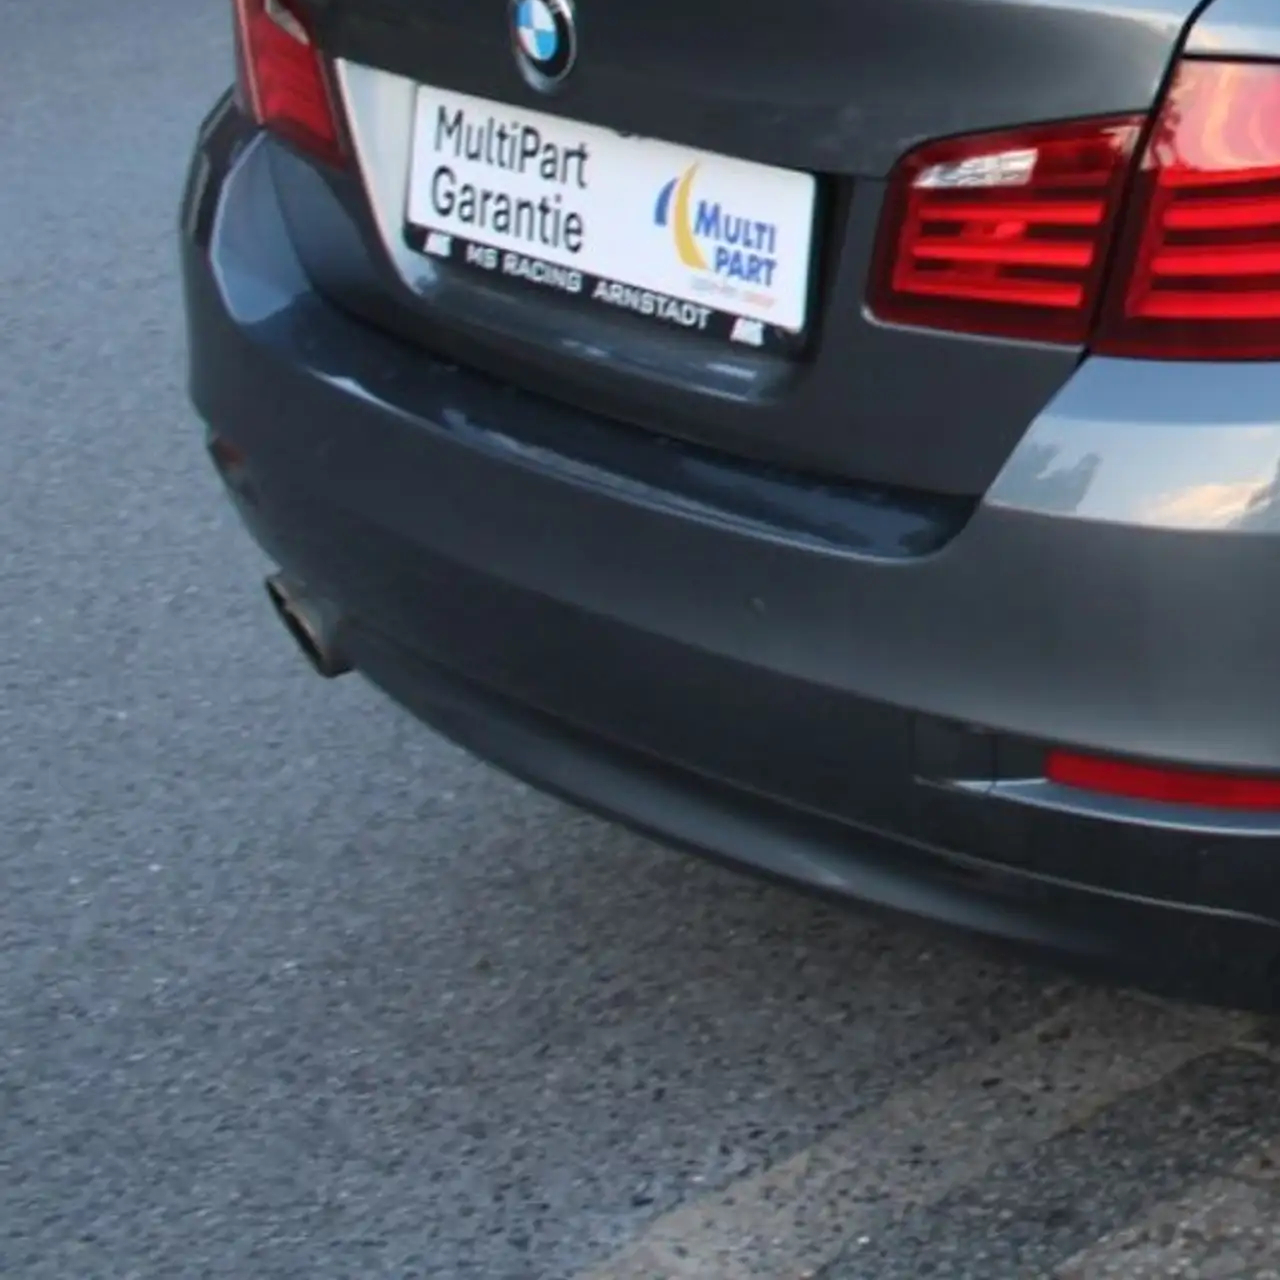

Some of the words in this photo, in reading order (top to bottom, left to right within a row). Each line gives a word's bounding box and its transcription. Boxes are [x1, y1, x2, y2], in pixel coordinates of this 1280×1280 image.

[433, 104, 589, 190] MultiPart
[431, 165, 584, 254] Garantie
[693, 199, 777, 255] MULTI
[502, 252, 583, 293] RACING
[591, 280, 713, 330] ARNSTADT
[715, 245, 778, 288] PART
